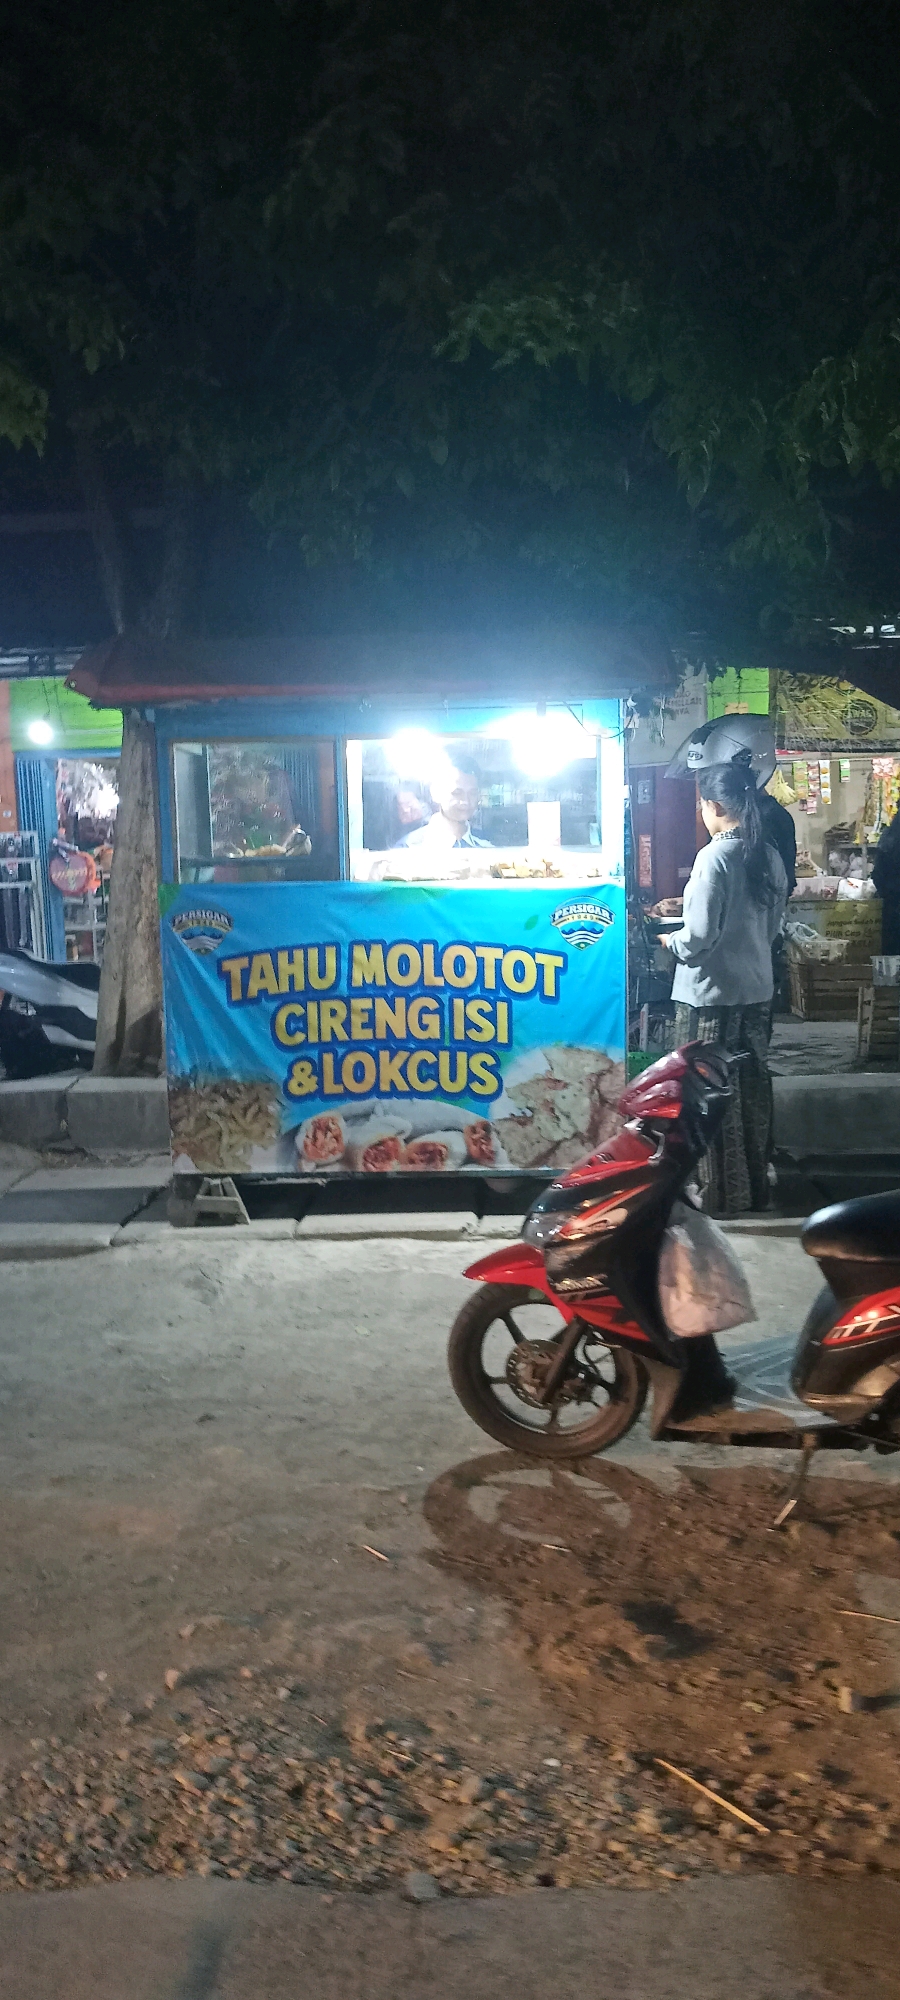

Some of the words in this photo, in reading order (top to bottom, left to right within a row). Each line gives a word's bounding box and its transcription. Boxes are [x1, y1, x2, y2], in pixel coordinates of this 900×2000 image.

[554, 904, 611, 921] PERSIGAR
[221, 944, 337, 1001] TAHU
[351, 941, 564, 998] MOLOTOT
[275, 998, 440, 1045] CIRENG
[453, 998, 510, 1044] ISI
